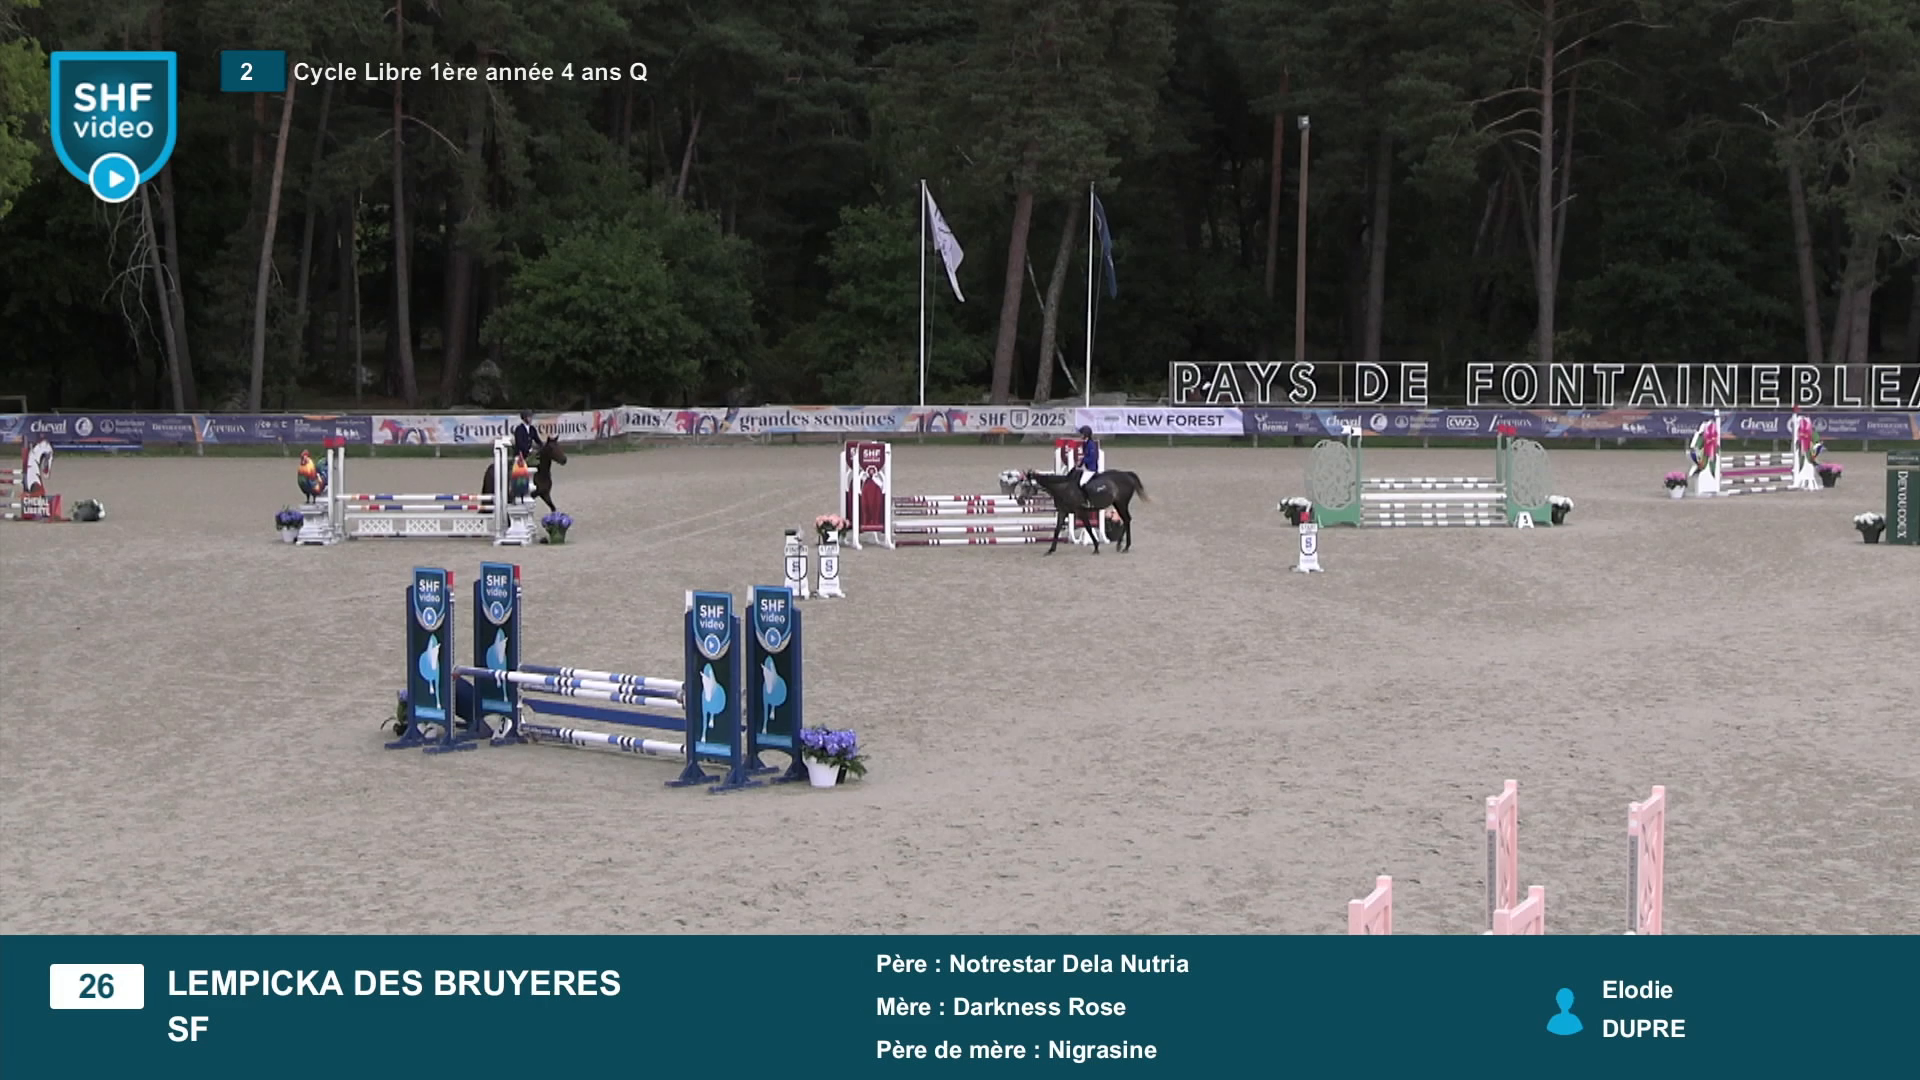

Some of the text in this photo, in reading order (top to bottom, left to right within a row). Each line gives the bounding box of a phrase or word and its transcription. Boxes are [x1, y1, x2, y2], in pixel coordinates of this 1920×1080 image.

[1173, 361, 1920, 408] PAYS DE FONTAINEBLE
[739, 410, 896, 432] grandes semaines
[979, 413, 1066, 426] SHF 2025
[1127, 415, 1162, 426] NEW
[1167, 415, 1224, 426] FOREST
[1741, 416, 1779, 432] Cheval
[30, 419, 67, 434] Cheval
[863, 449, 881, 457] SHF
[419, 579, 440, 592] SHF
[486, 575, 507, 587] SHF
[419, 593, 441, 603] video
[486, 587, 508, 599] video
[700, 605, 724, 618] SHF
[760, 599, 785, 612] SHF
[700, 618, 725, 631] video
[760, 613, 785, 625] video
